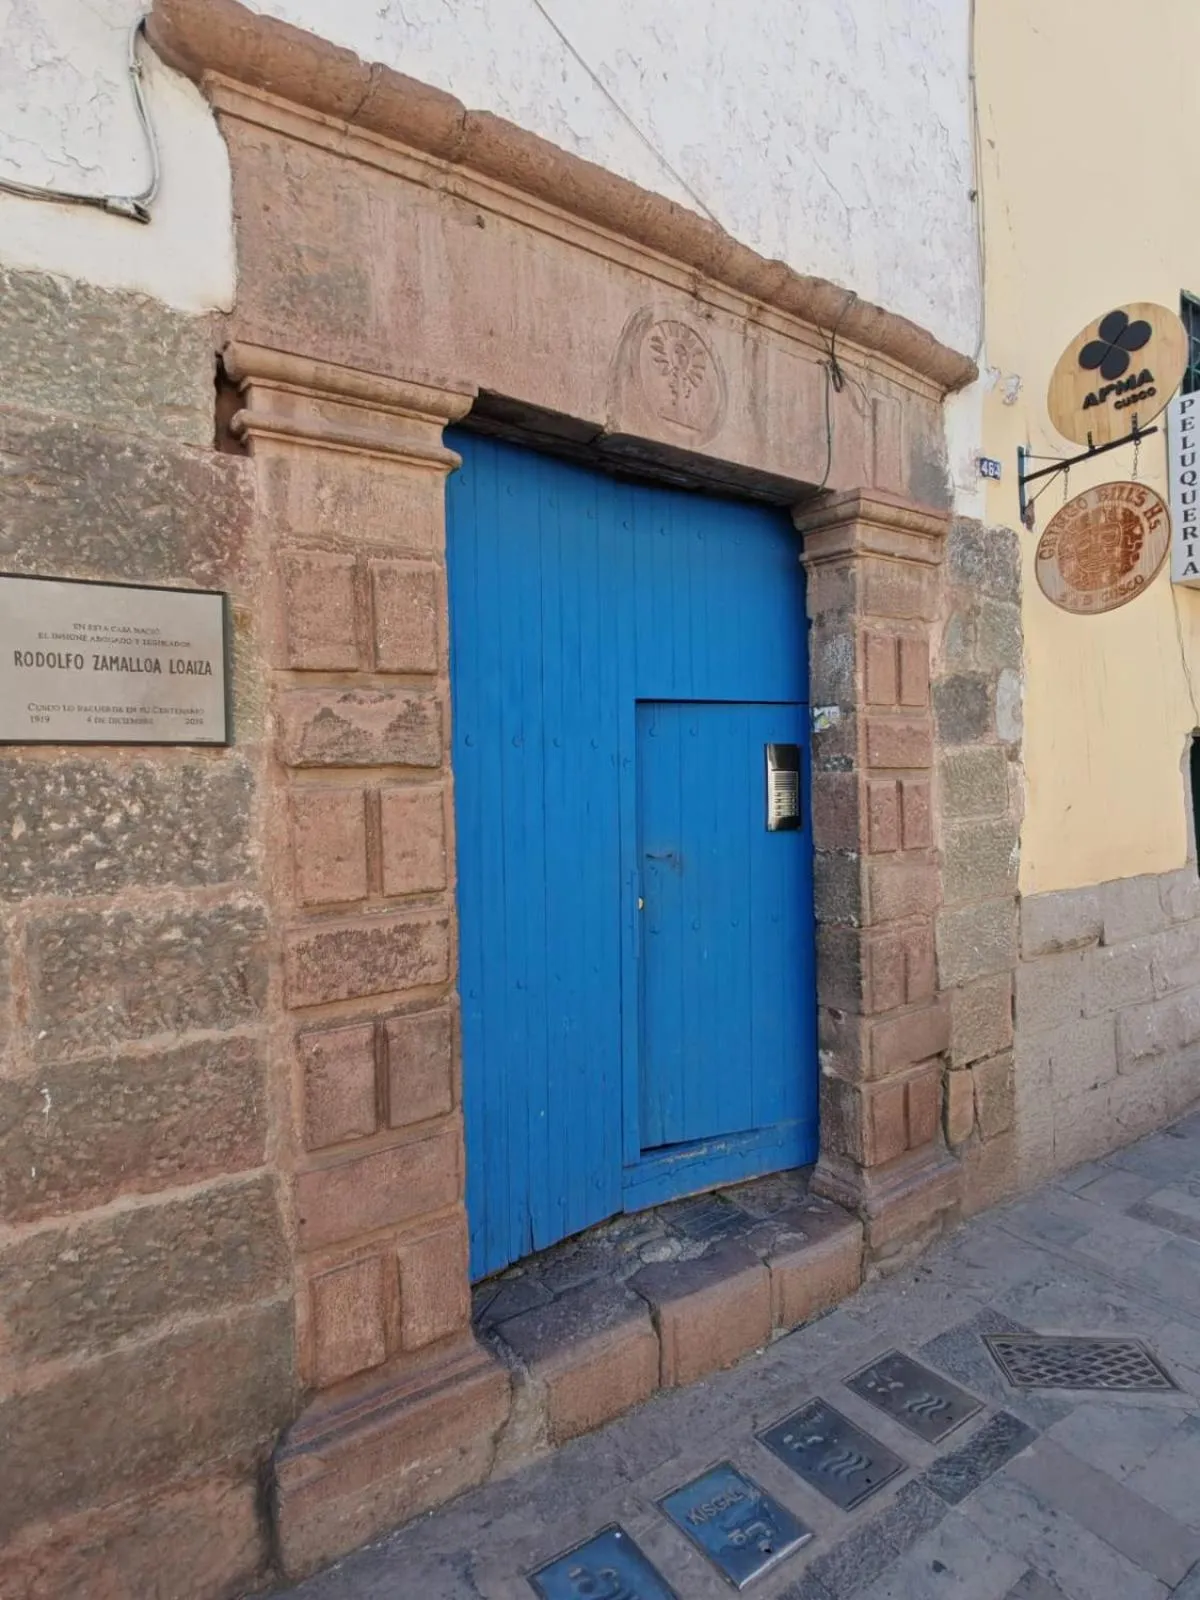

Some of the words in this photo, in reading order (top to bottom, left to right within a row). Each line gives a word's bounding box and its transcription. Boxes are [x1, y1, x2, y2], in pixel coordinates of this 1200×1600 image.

[1083, 368, 1154, 410] APMA
[1114, 387, 1157, 410] CUSCO
[1180, 399, 1199, 576] PELUQUERIA
[14, 650, 84, 670] RODOLFO
[93, 655, 162, 674] ZAMALLOA
[169, 659, 213, 676] LOAIZA
[30, 715, 50, 724] 1919
